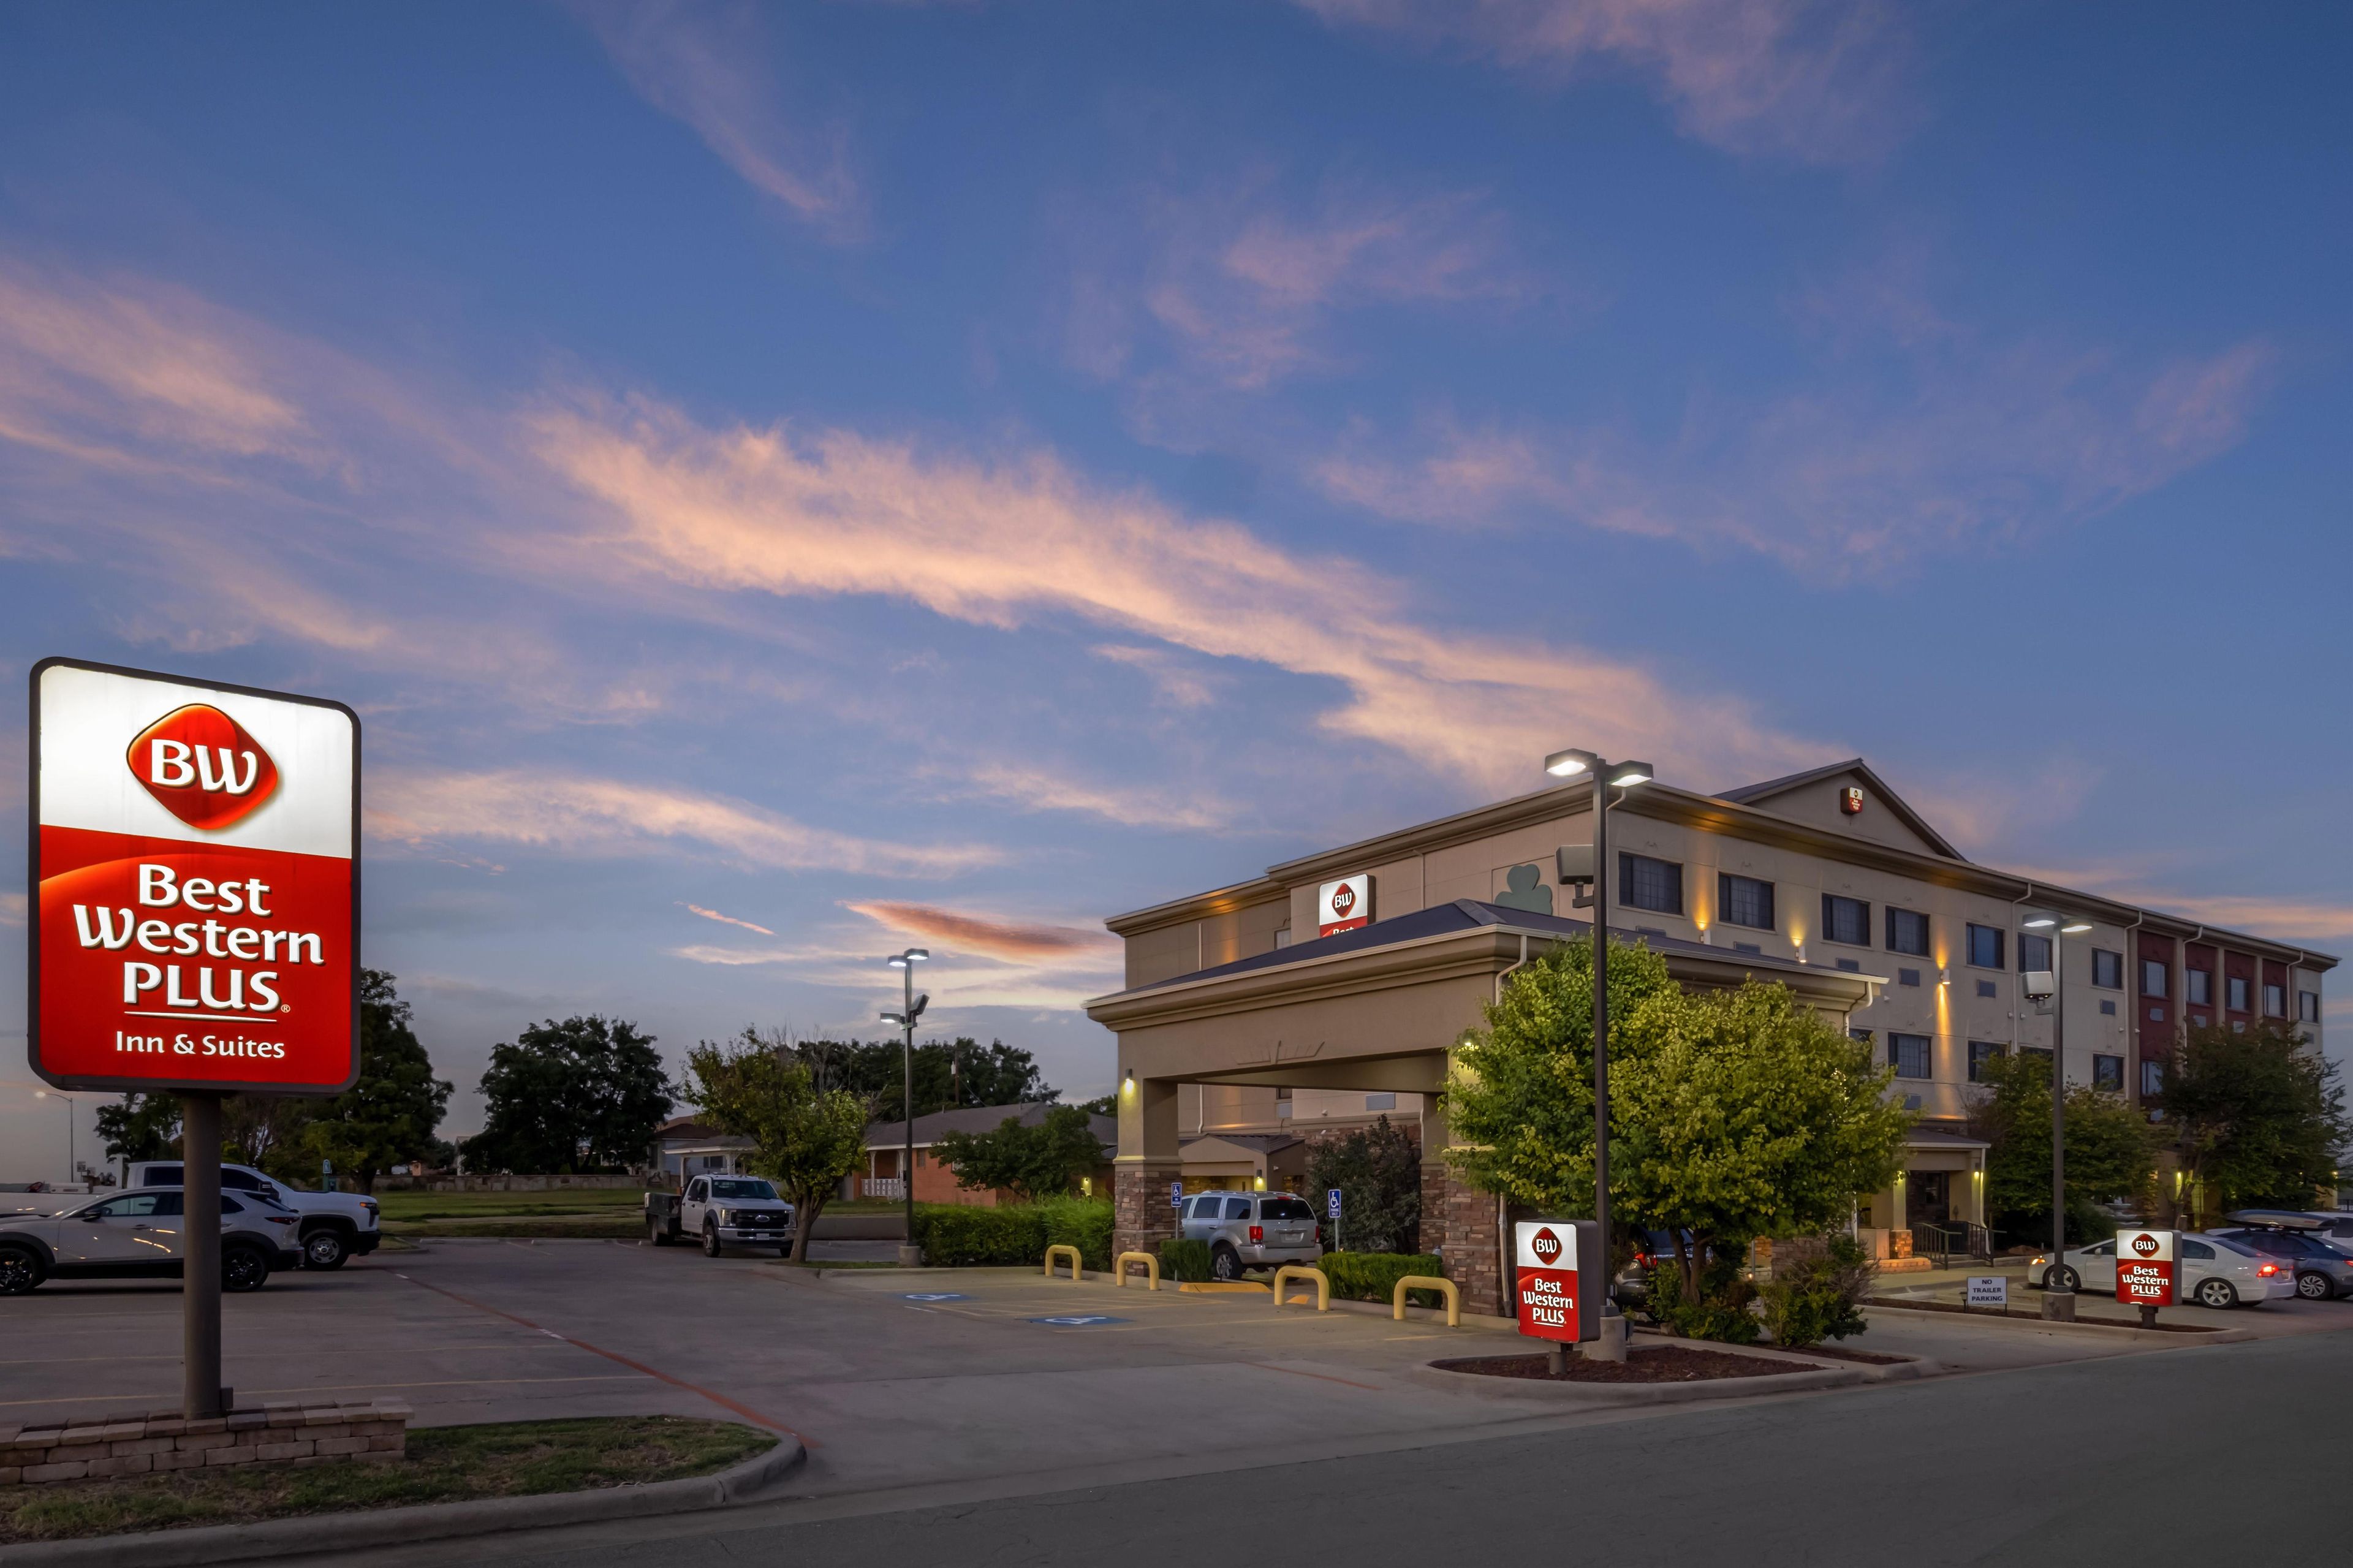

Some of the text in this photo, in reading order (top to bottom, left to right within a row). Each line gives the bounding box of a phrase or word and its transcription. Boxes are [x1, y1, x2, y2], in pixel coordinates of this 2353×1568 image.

[151, 739, 257, 794] BW
[139, 864, 271, 916] Best
[1335, 892, 1352, 908] BW
[73, 904, 324, 964] Western
[116, 1031, 285, 1058] Inn & Suites
[1536, 1238, 1557, 1254] BW
[2135, 1240, 2155, 1251] BW
[2133, 1266, 2159, 1276] Best
[1534, 1278, 1562, 1293] Best
[2122, 1274, 2169, 1286] Western
[2131, 1284, 2161, 1295] PLUS
[1523, 1290, 1574, 1309] Western
[1533, 1307, 1565, 1324] PLUS
